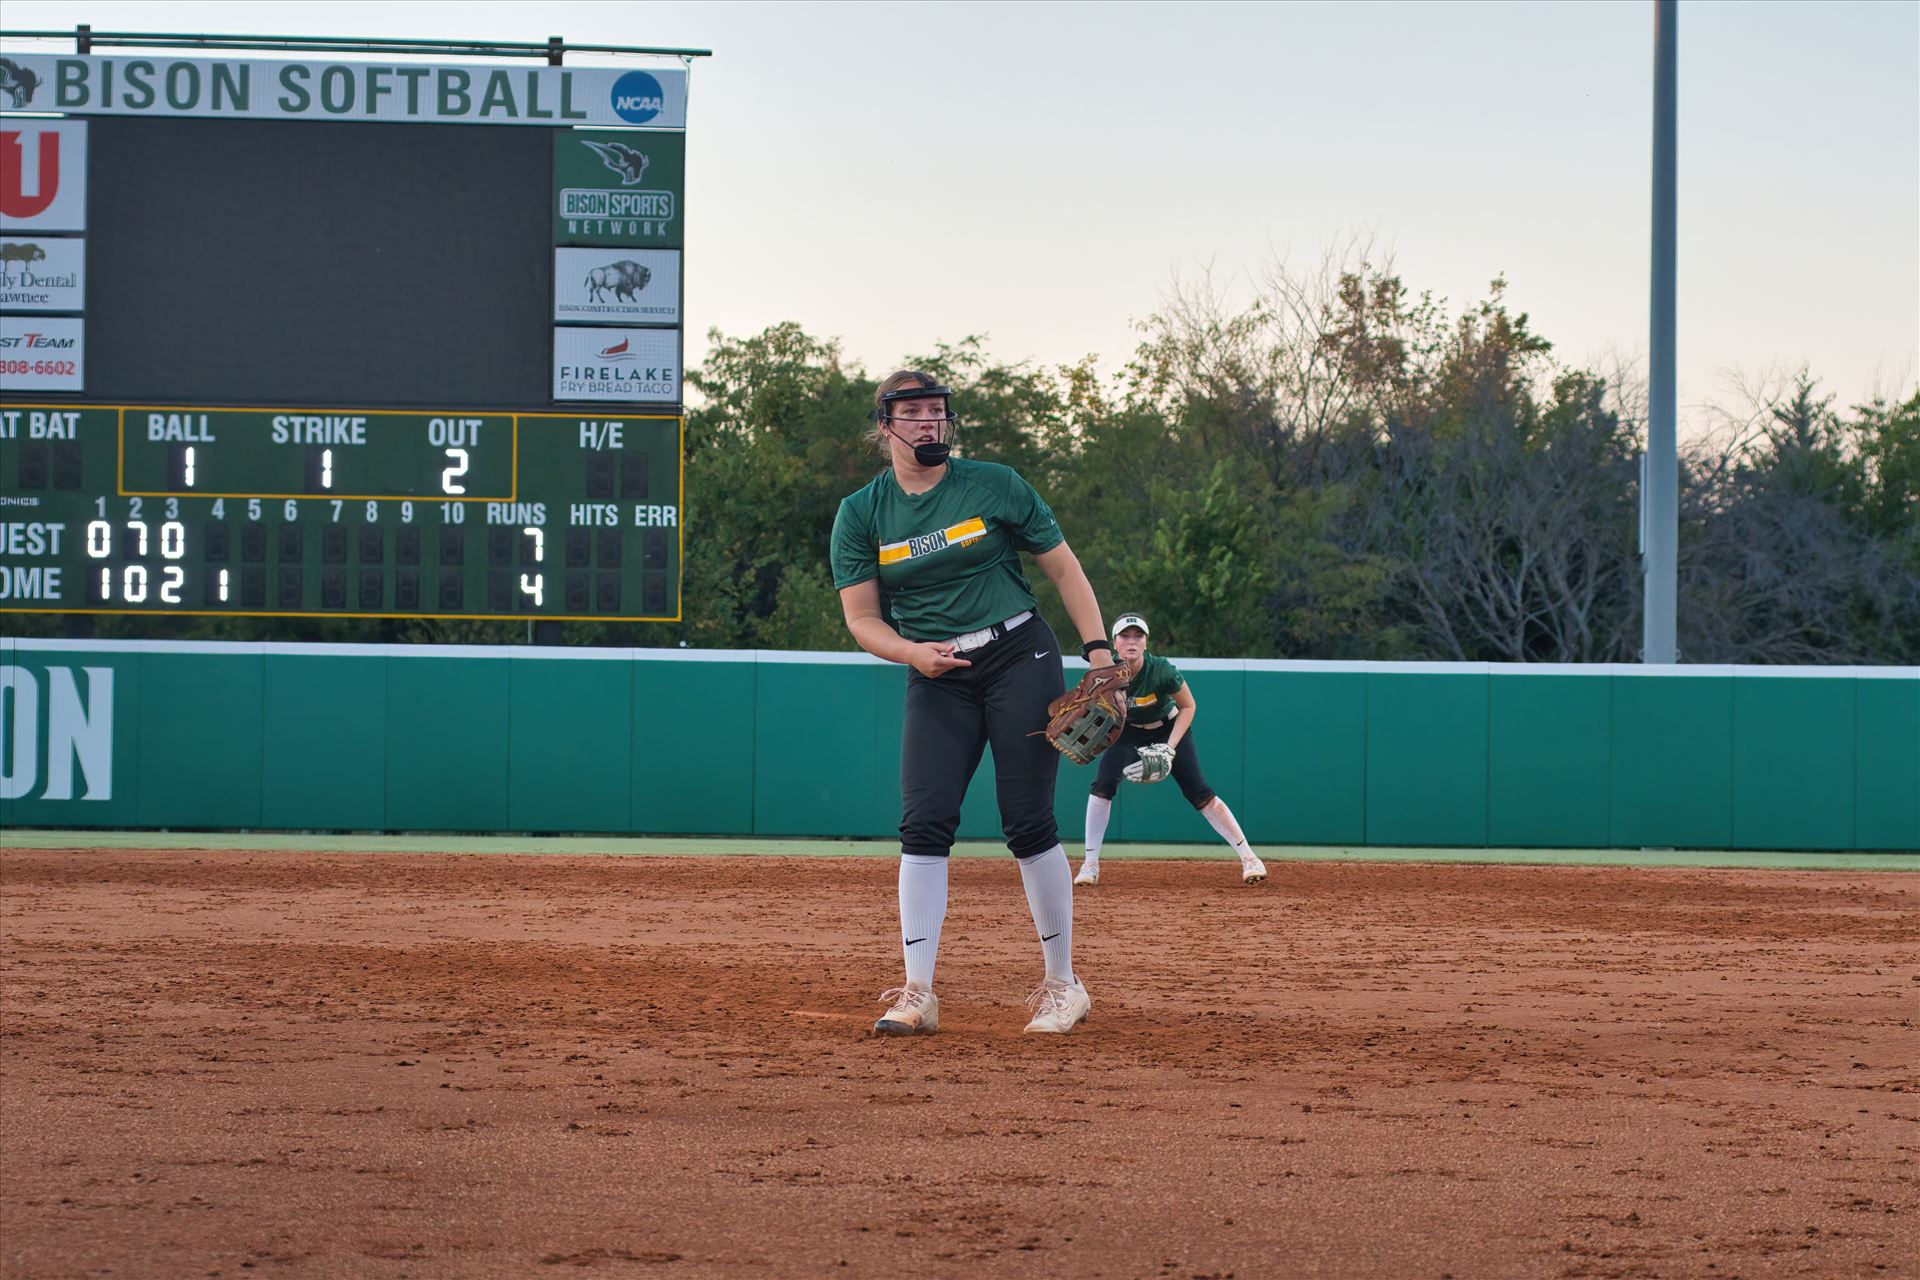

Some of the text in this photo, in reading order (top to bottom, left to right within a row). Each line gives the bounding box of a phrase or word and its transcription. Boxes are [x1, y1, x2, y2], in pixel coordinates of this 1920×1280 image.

[55, 59, 588, 120] BISON SOFTBALL
[616, 96, 661, 110] NCAA
[567, 193, 669, 216] BISON SPORTS
[568, 220, 666, 236] NETWORK
[20, 271, 77, 288] Dental
[23, 333, 75, 348] TEAM
[560, 366, 673, 381] FIRELAKE
[560, 380, 673, 394] FRY BREAD TACO
[29, 411, 81, 440] BAT
[148, 413, 215, 442] BALL
[271, 415, 366, 445] STRIKE
[428, 418, 483, 447] OUT
[579, 421, 624, 451] H/E
[185, 446, 195, 487] 1
[322, 449, 332, 488] 1
[442, 448, 469, 494] 2
[95, 496, 677, 527] 1 2 3 4 5 6 7 8 9 10 RUNS HITS ERR
[87, 520, 543, 562] 0 7 0 7
[908, 529, 949, 558] BISON
[102, 565, 543, 606] 1 0 2 1 4
[0, 665, 114, 800] ON
